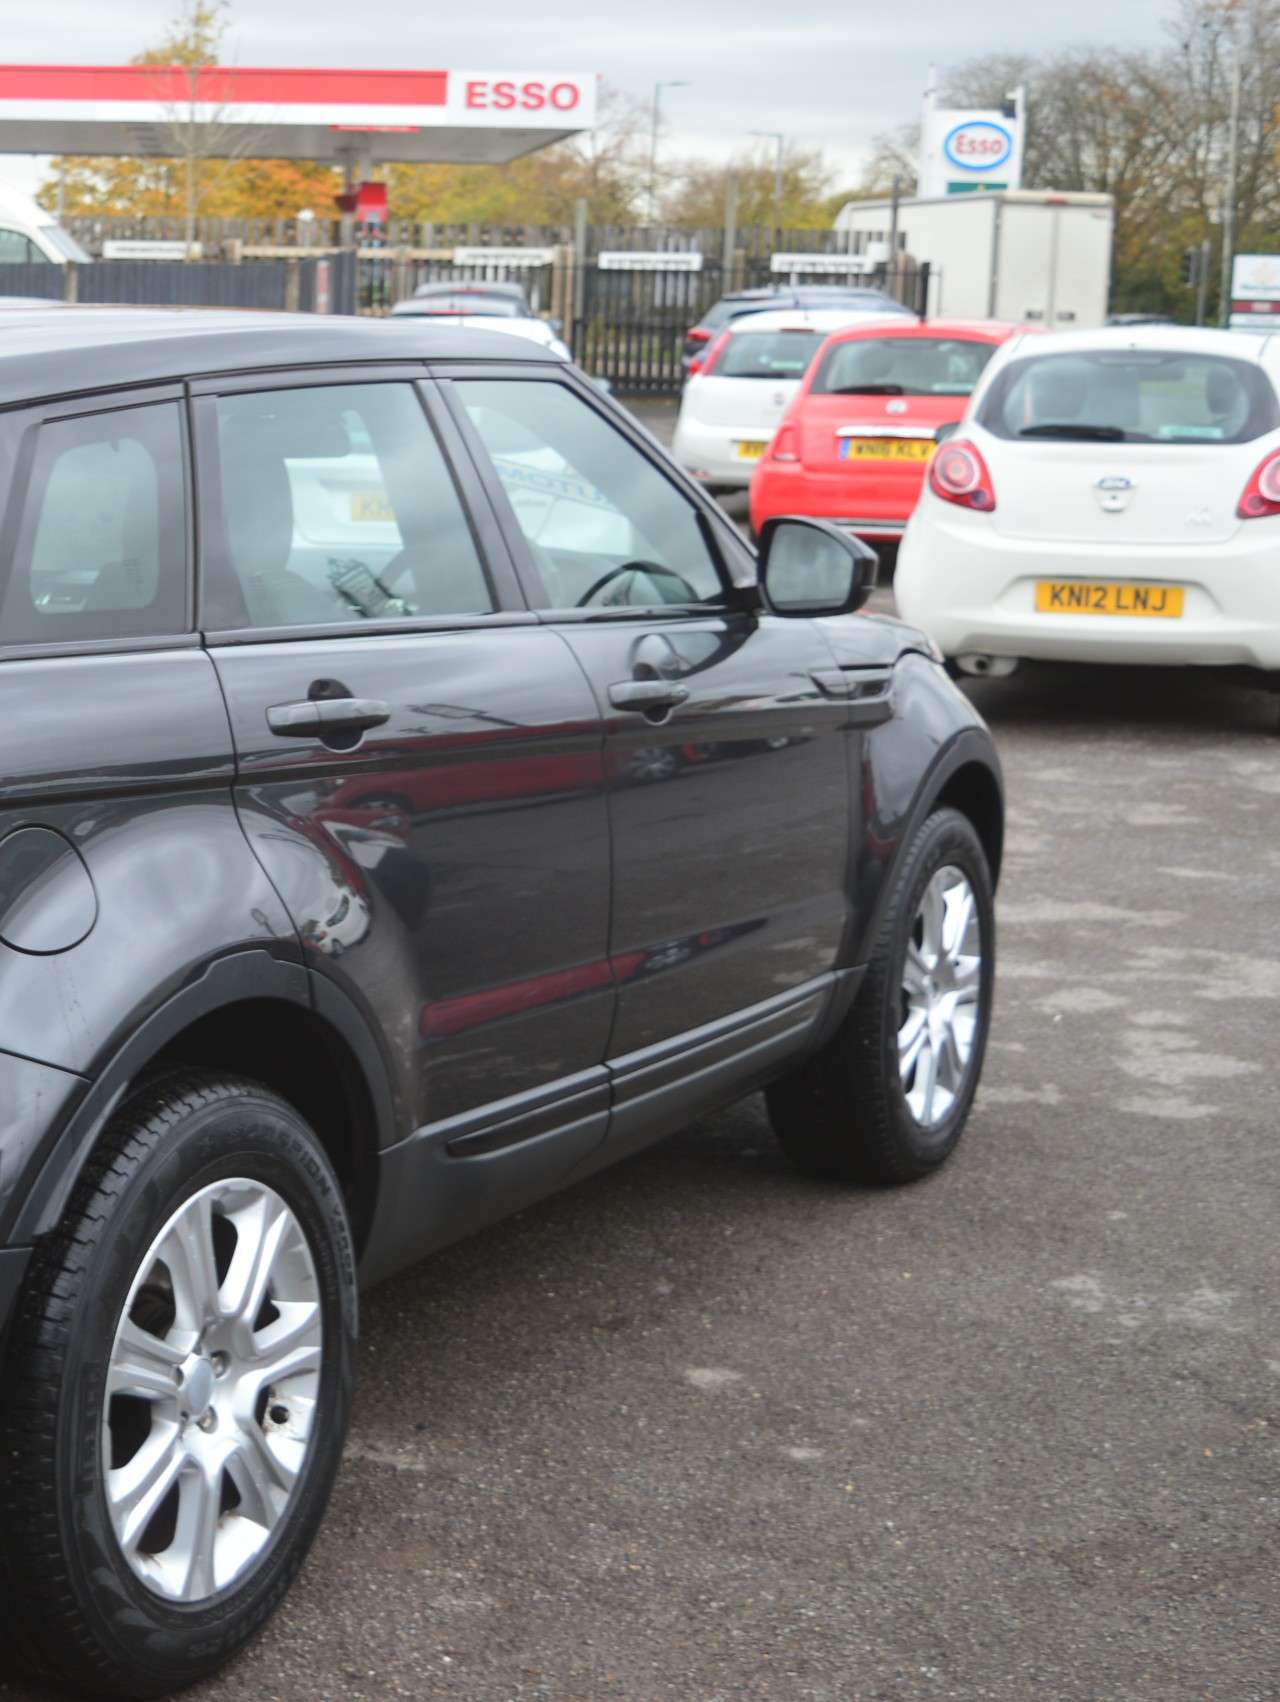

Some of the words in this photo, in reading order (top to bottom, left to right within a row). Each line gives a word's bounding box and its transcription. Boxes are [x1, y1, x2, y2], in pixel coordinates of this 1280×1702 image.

[465, 81, 581, 111] ESSO
[954, 133, 1004, 155] Esso
[1049, 584, 1108, 609] KN12
[1115, 586, 1168, 613] LNJ
